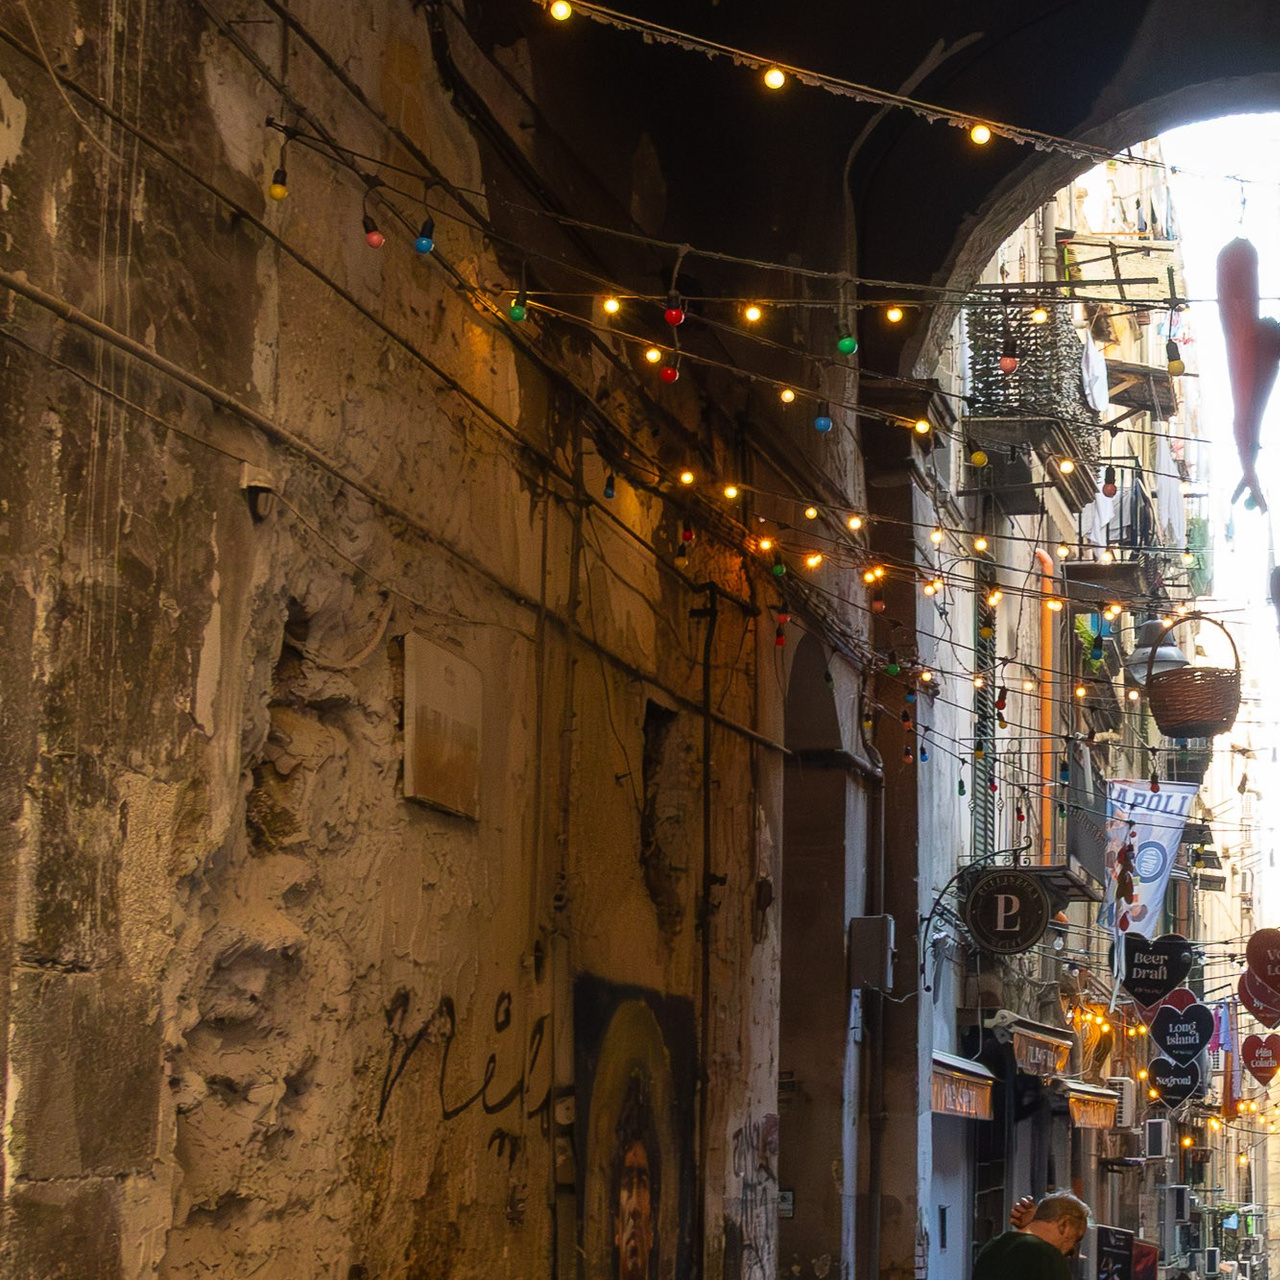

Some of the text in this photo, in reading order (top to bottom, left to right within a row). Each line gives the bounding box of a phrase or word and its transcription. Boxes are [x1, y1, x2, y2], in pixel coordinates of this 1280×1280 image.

[1133, 952, 1169, 964] Beer
[1131, 965, 1169, 980] Draft
[1168, 1021, 1197, 1035] Long
[1166, 1032, 1200, 1045] Island
[1156, 1075, 1192, 1088] Negroni
